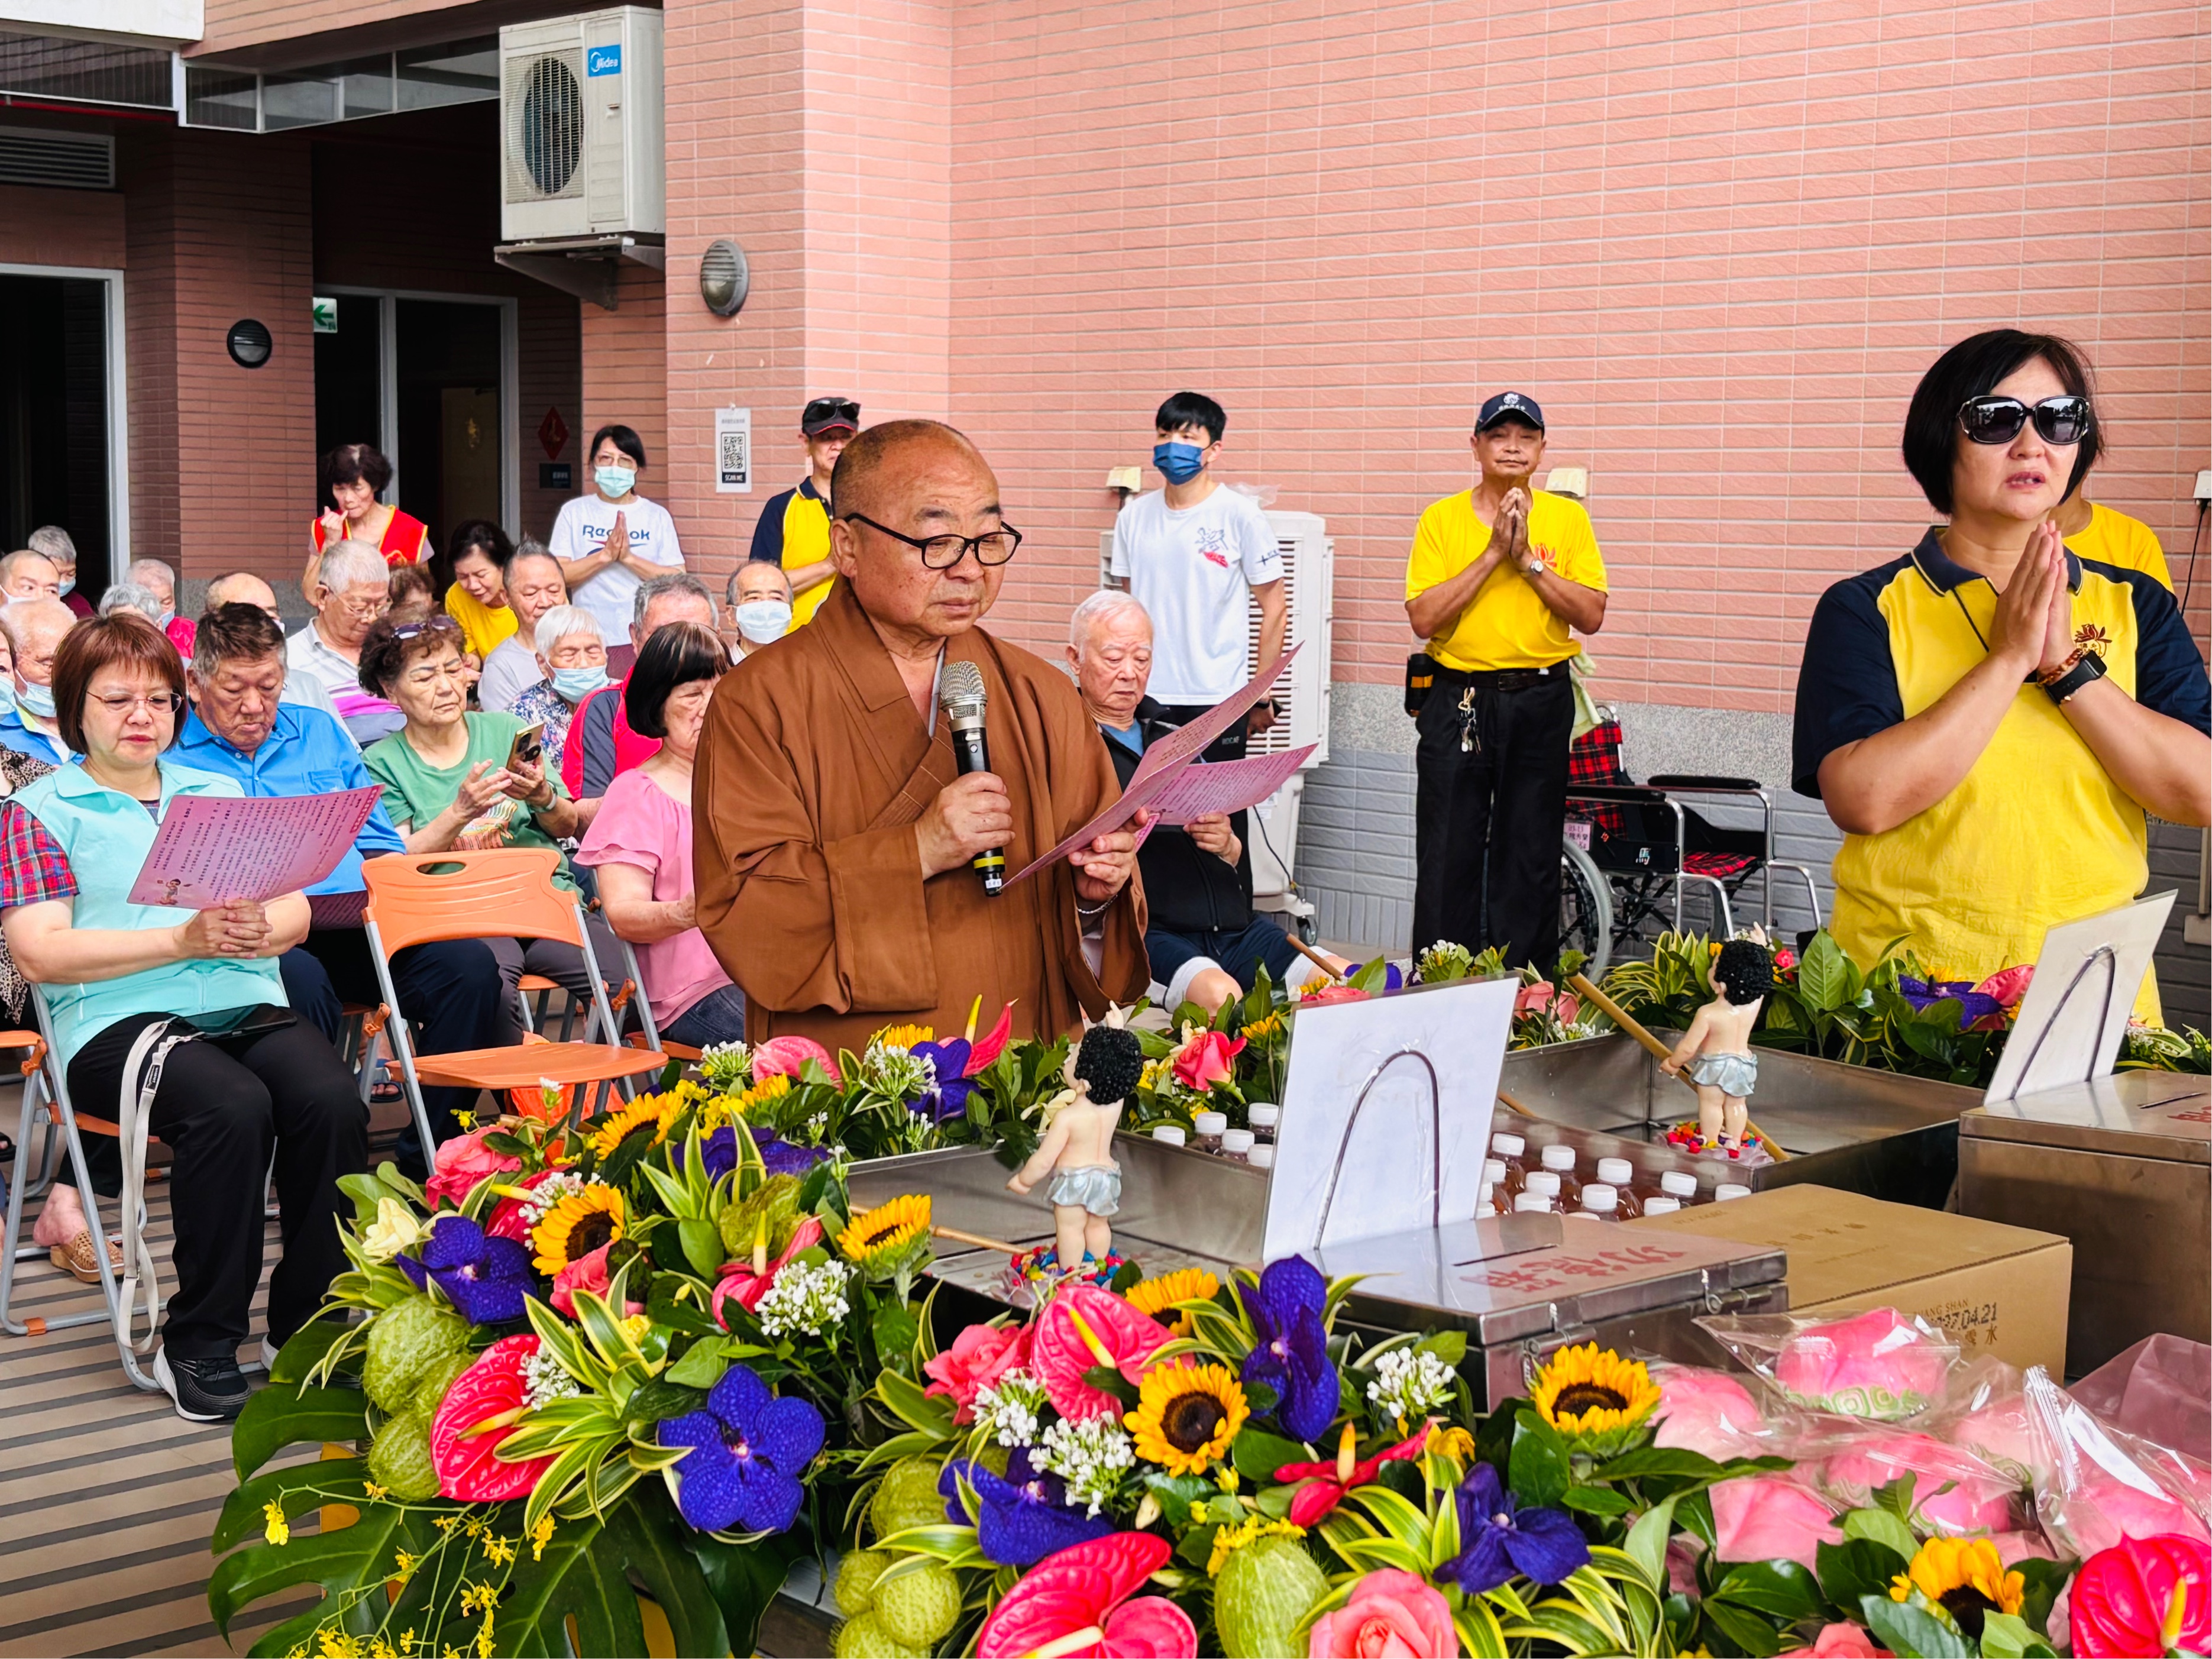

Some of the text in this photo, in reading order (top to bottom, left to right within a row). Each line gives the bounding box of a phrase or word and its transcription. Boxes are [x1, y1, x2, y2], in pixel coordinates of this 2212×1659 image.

[594, 55, 619, 70] Midea
[583, 524, 650, 540] Reok
[1946, 1299, 1968, 1313] SHAN
